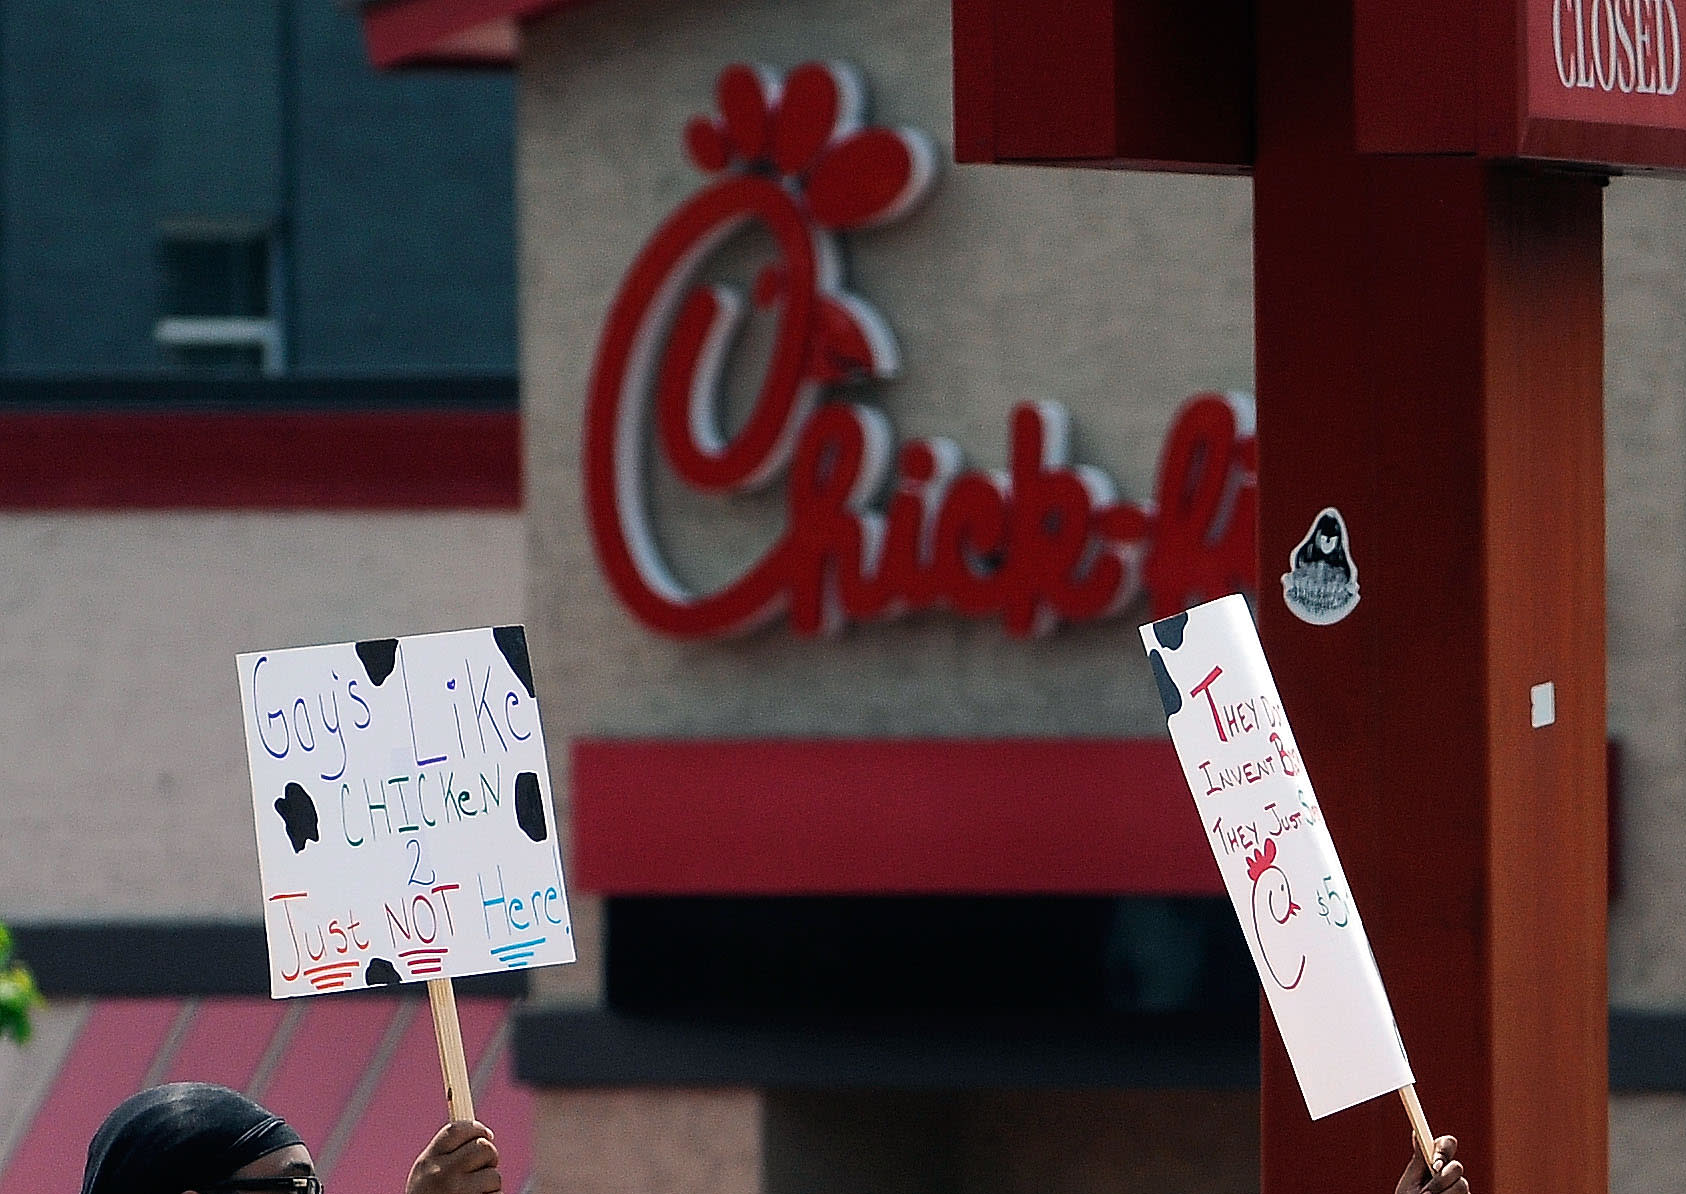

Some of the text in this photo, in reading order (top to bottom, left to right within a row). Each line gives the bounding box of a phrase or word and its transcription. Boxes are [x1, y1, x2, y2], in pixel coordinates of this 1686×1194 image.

[1552, 0, 1681, 95] CLOSED
[253, 656, 371, 781] Gay's
[406, 839, 435, 886] 2
[268, 891, 369, 981] Just
[385, 884, 460, 947] NOT
